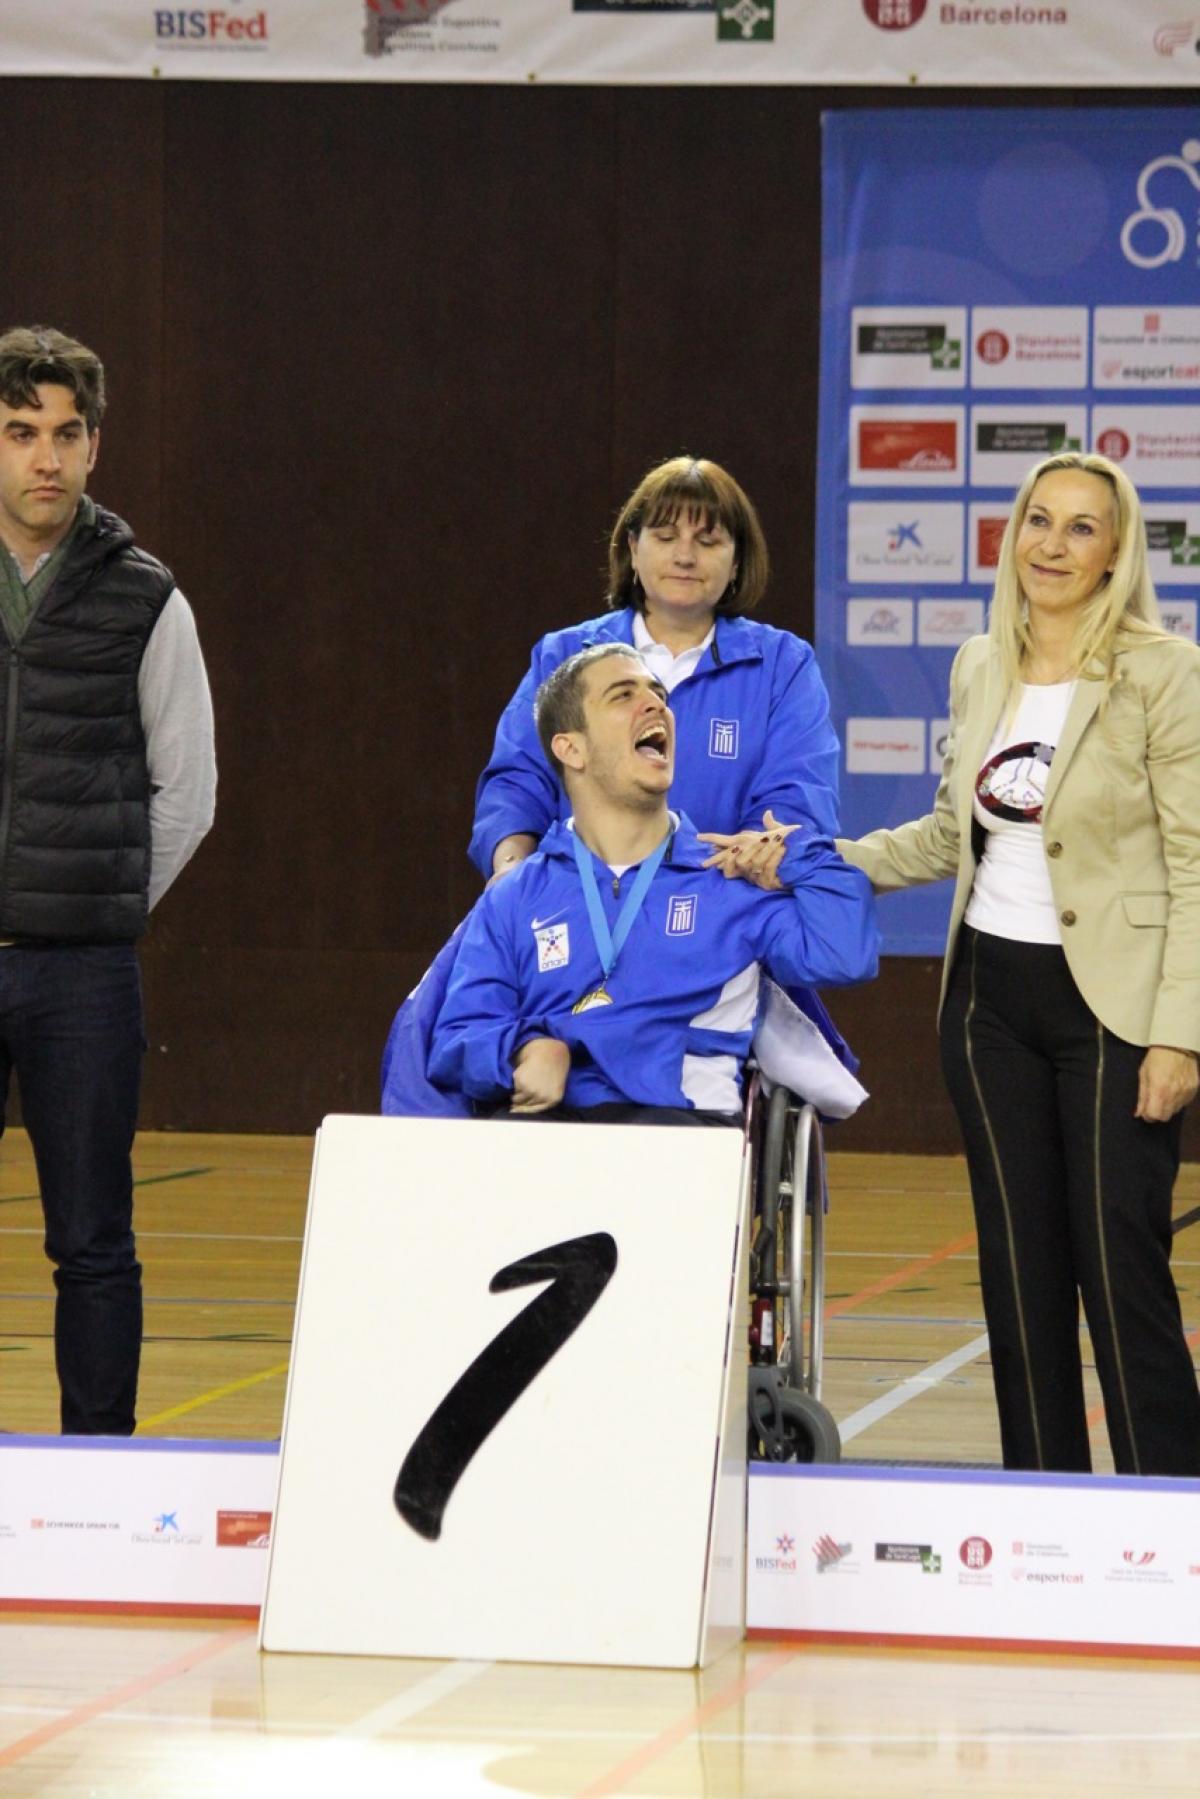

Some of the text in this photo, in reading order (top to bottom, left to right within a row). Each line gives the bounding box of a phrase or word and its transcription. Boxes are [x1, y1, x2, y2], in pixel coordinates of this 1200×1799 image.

[940, 5, 1067, 24] Barcelona
[155, 11, 268, 38] BISFed
[393, 1232, 617, 1542] 1
[755, 1558, 797, 1569] BISFed
[1026, 1571, 1084, 1585] esportcat
